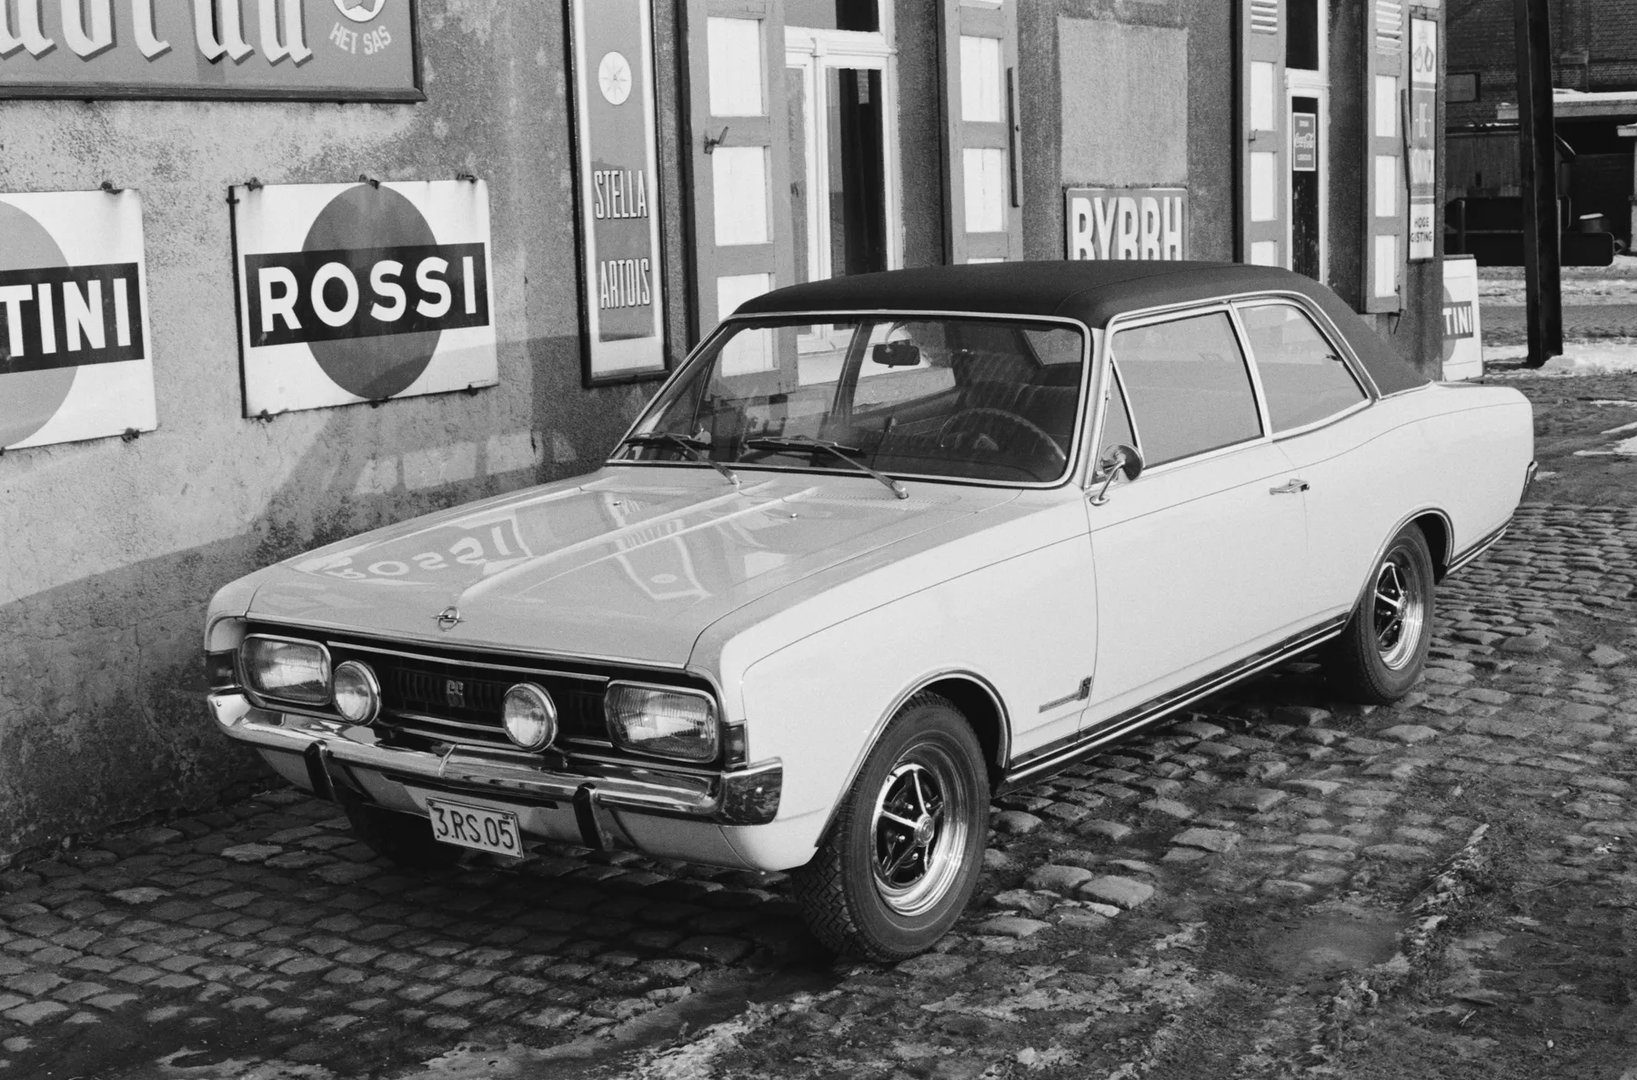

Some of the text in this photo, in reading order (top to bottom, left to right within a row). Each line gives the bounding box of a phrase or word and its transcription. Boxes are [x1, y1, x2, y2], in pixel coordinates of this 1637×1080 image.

[329, 21, 359, 55] HET
[363, 25, 392, 55] SAS
[594, 169, 649, 219] STELLA
[258, 255, 477, 333] ROSSI
[600, 257, 651, 310] ARTOIS
[431, 806, 514, 850] 3.RS.05
